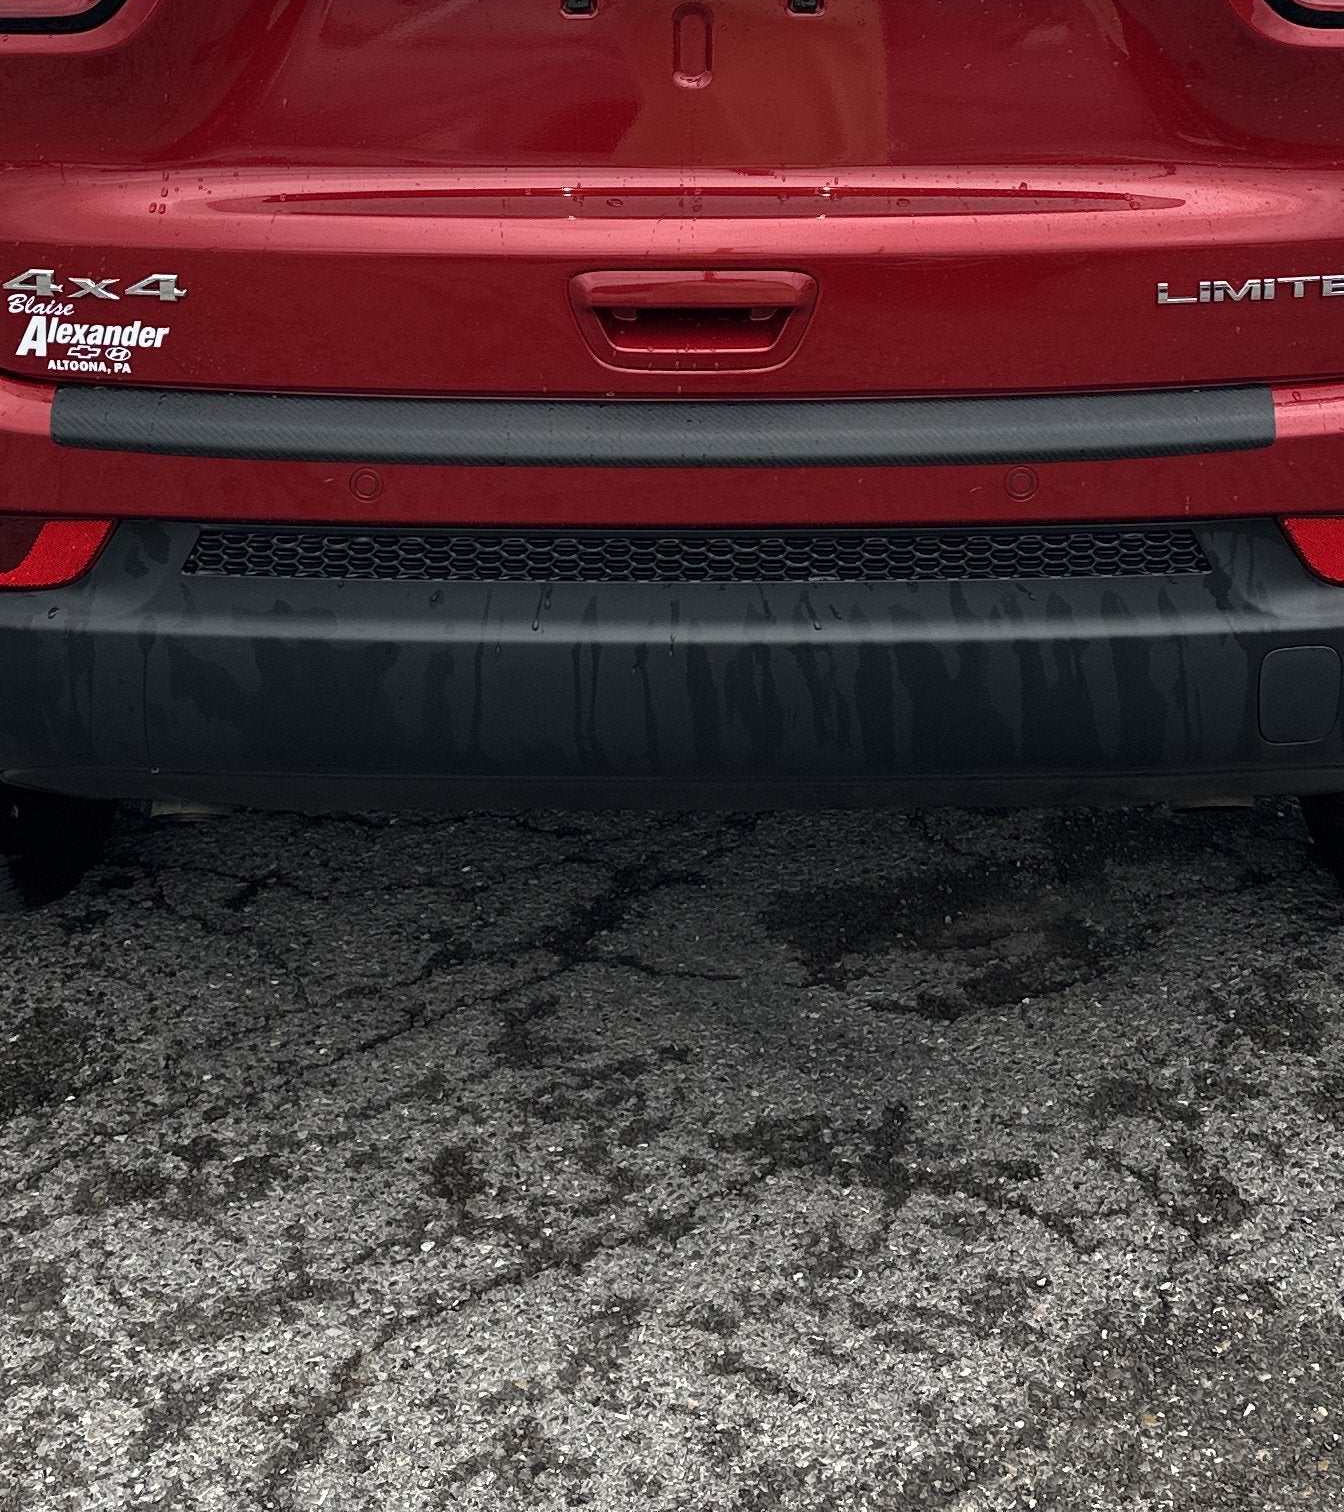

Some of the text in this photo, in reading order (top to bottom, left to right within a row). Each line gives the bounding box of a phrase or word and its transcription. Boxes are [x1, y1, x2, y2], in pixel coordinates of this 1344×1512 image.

[2, 269, 187, 301] 4x4
[7, 294, 74, 316] Blaise
[15, 315, 170, 357] Alexander
[47, 360, 132, 374] ALTOONA, PA
